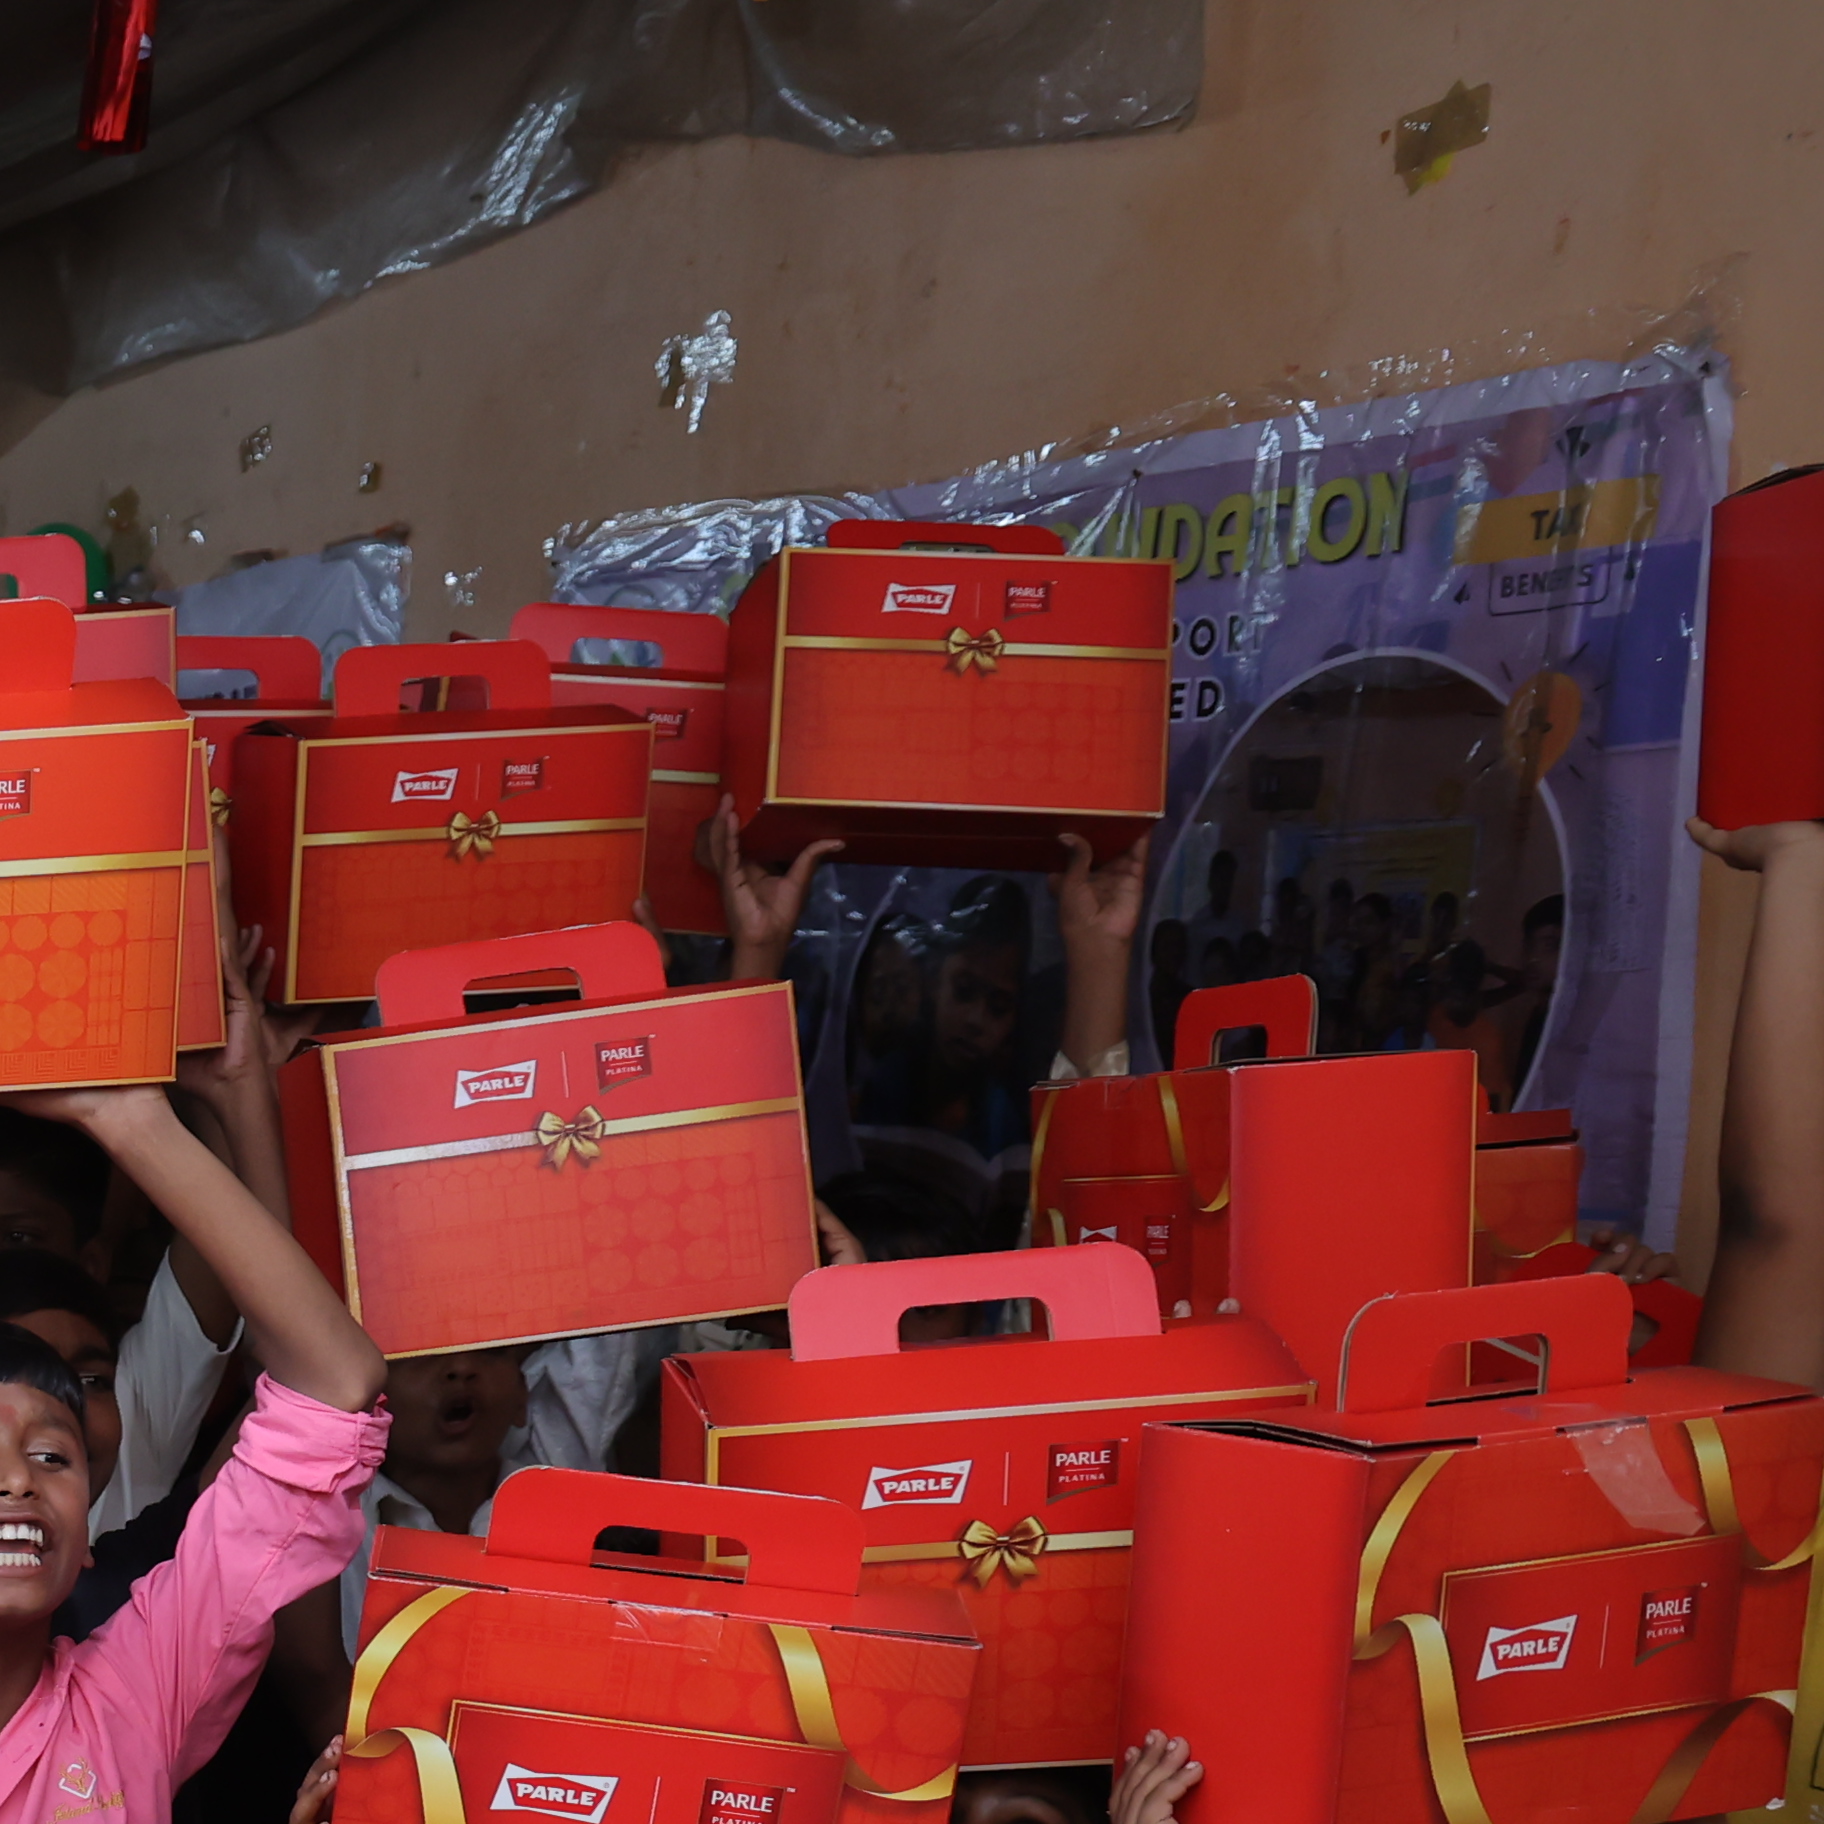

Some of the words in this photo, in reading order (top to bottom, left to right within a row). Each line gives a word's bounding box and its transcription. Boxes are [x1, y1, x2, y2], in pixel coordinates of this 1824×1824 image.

[896, 593, 944, 604] PARLE
[1008, 586, 1045, 598] PARLE
[505, 764, 540, 776] PARLE
[403, 779, 447, 791] PARLE
[601, 1045, 644, 1062] PARLE
[605, 1065, 643, 1076] PLATINA
[468, 1075, 525, 1093] PARLE
[1055, 1450, 1111, 1467] PARLE
[882, 1476, 954, 1494] PARLE
[1058, 1473, 1105, 1483] PLATINA
[1645, 1597, 1692, 1619] PARLE
[1645, 1625, 1685, 1639] PLATINA
[1496, 1636, 1561, 1660] PARLE
[516, 1782, 597, 1807] PARLE
[710, 1790, 774, 1813] PARLE
